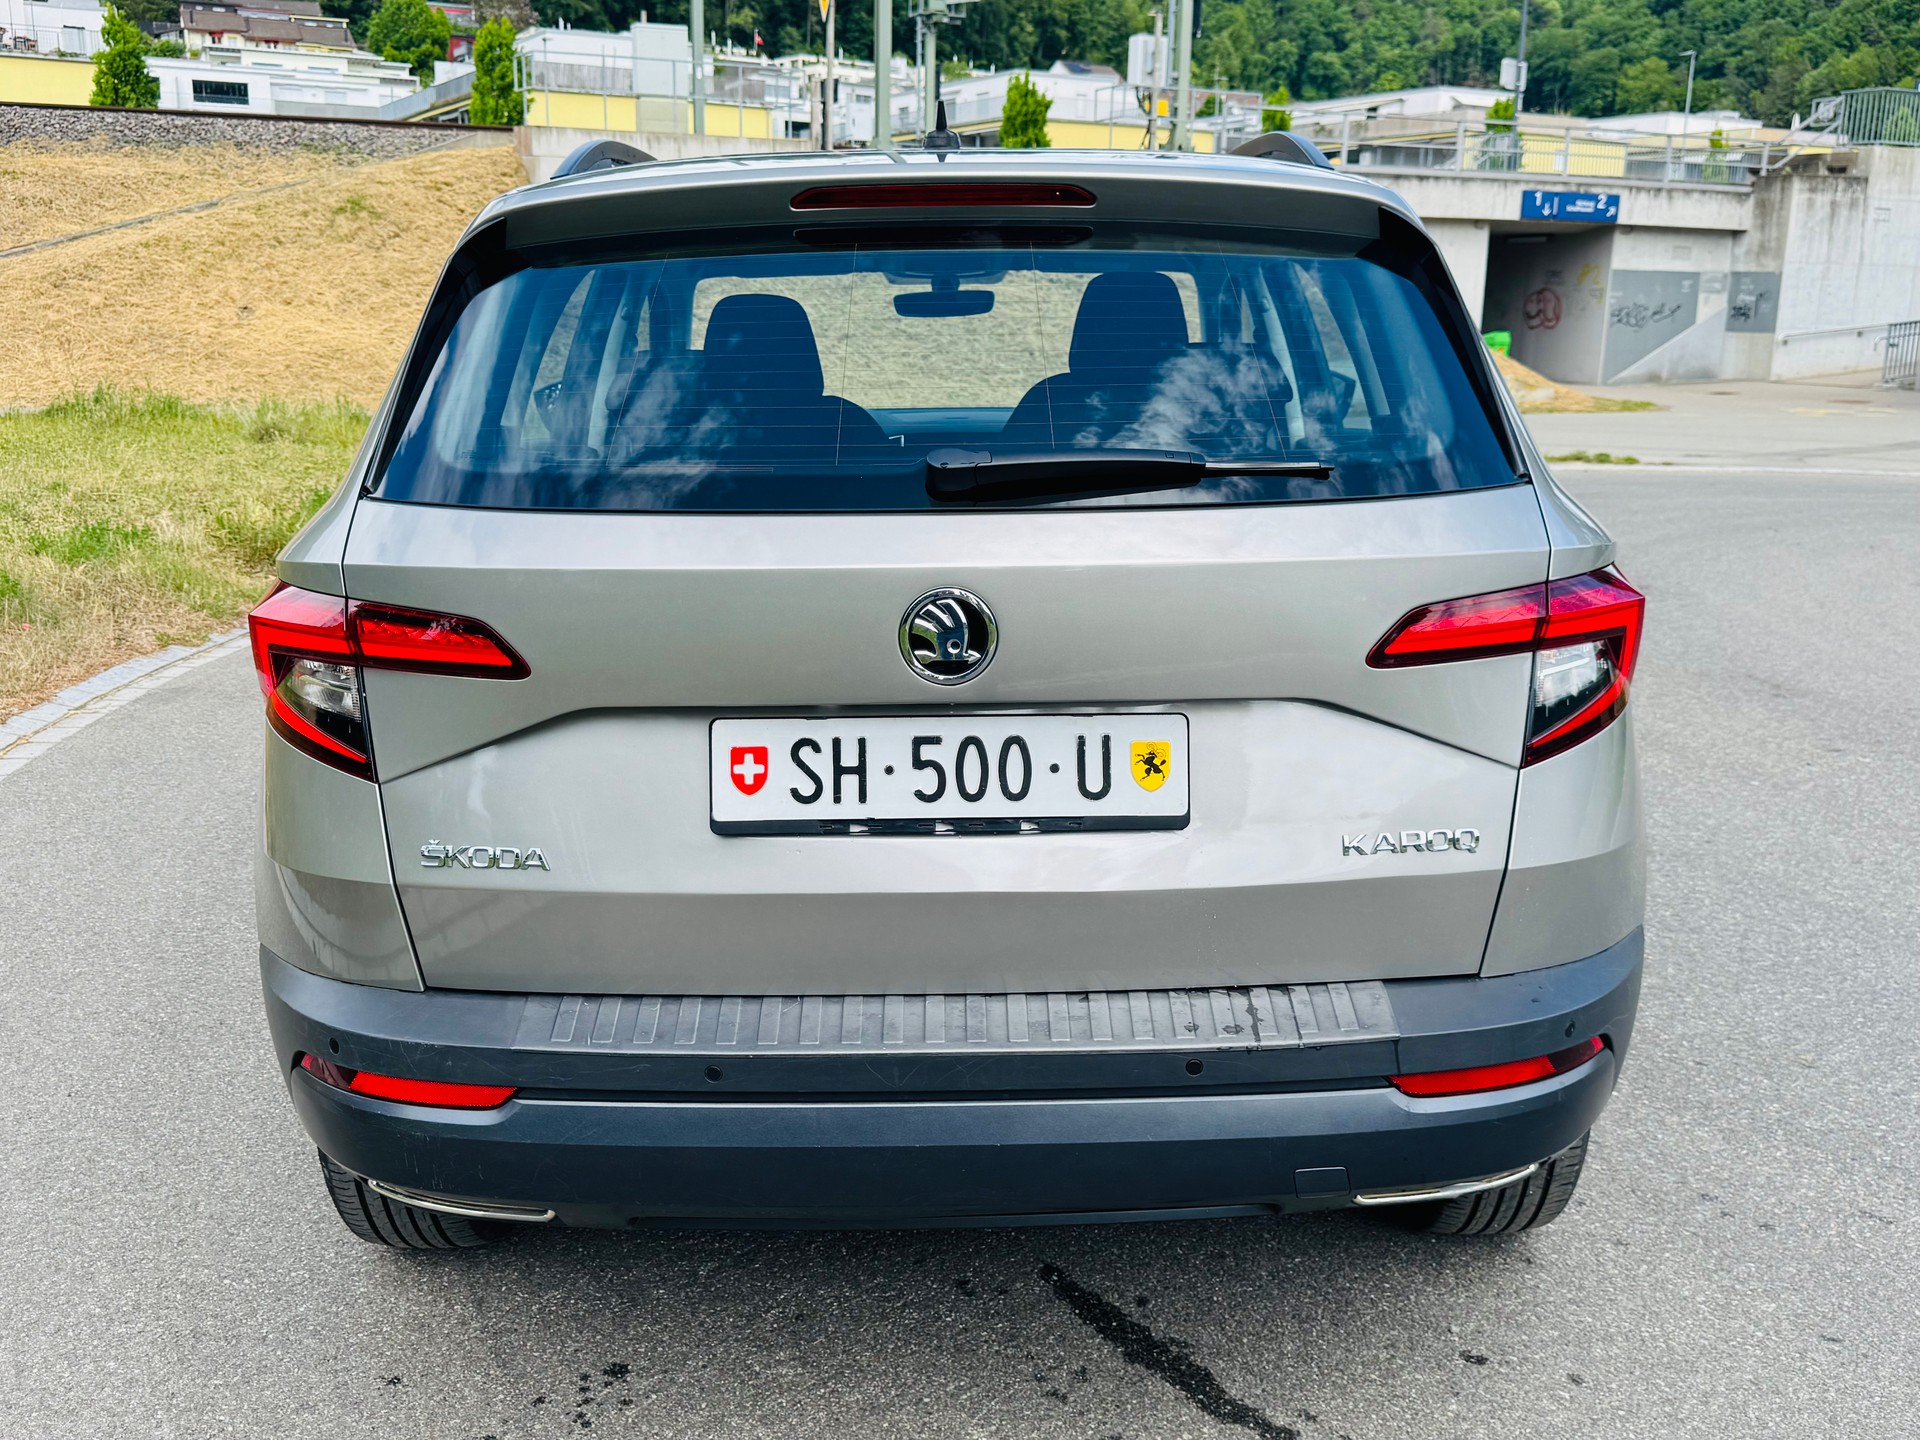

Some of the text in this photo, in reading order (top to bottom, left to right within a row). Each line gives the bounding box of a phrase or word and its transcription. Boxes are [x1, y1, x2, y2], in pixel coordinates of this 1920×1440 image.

[1534, 191, 1543, 207] 1
[1596, 193, 1608, 210] 2
[1342, 828, 1480, 857] KAROQ
[420, 839, 551, 871] ŠKODA
